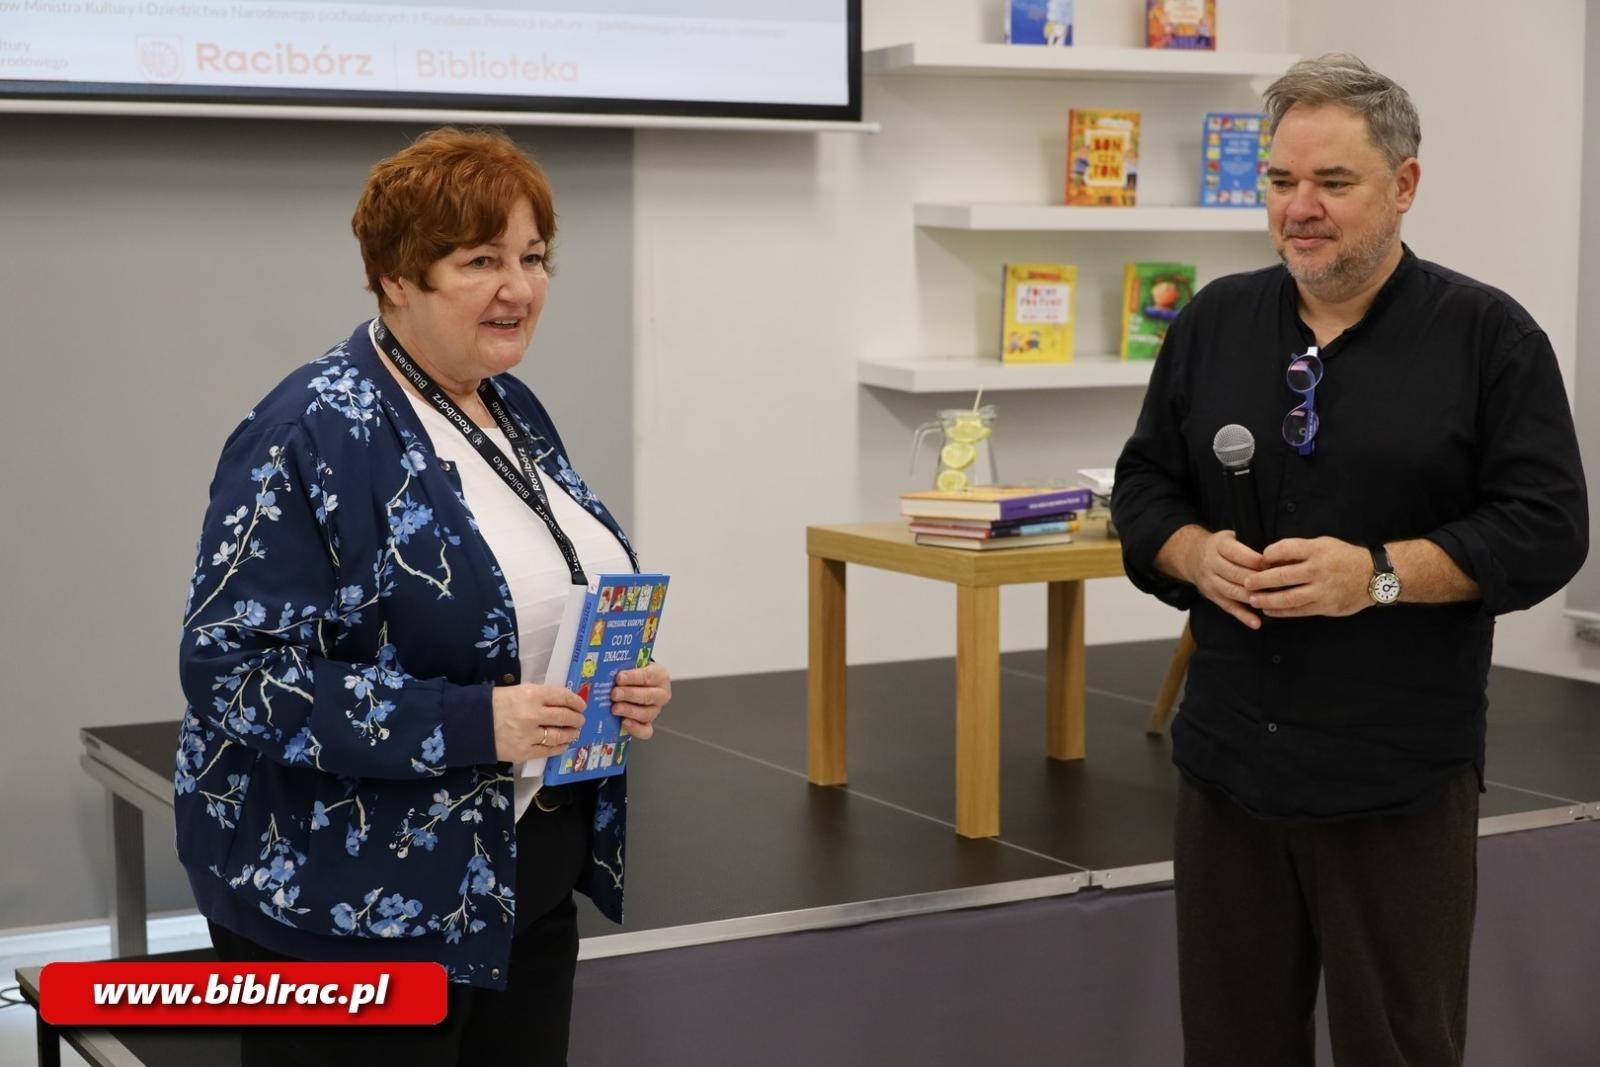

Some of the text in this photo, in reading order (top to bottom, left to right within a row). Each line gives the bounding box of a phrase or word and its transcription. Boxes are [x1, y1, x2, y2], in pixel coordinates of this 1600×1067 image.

[195, 41, 579, 82] Racibórz Biblioteka
[391, 347, 473, 435] Racibórz Biblioteka
[492, 401, 542, 491] Racibórz Biblioteka
[492, 455, 531, 500] Biblioteka
[612, 634, 633, 646] CO TO
